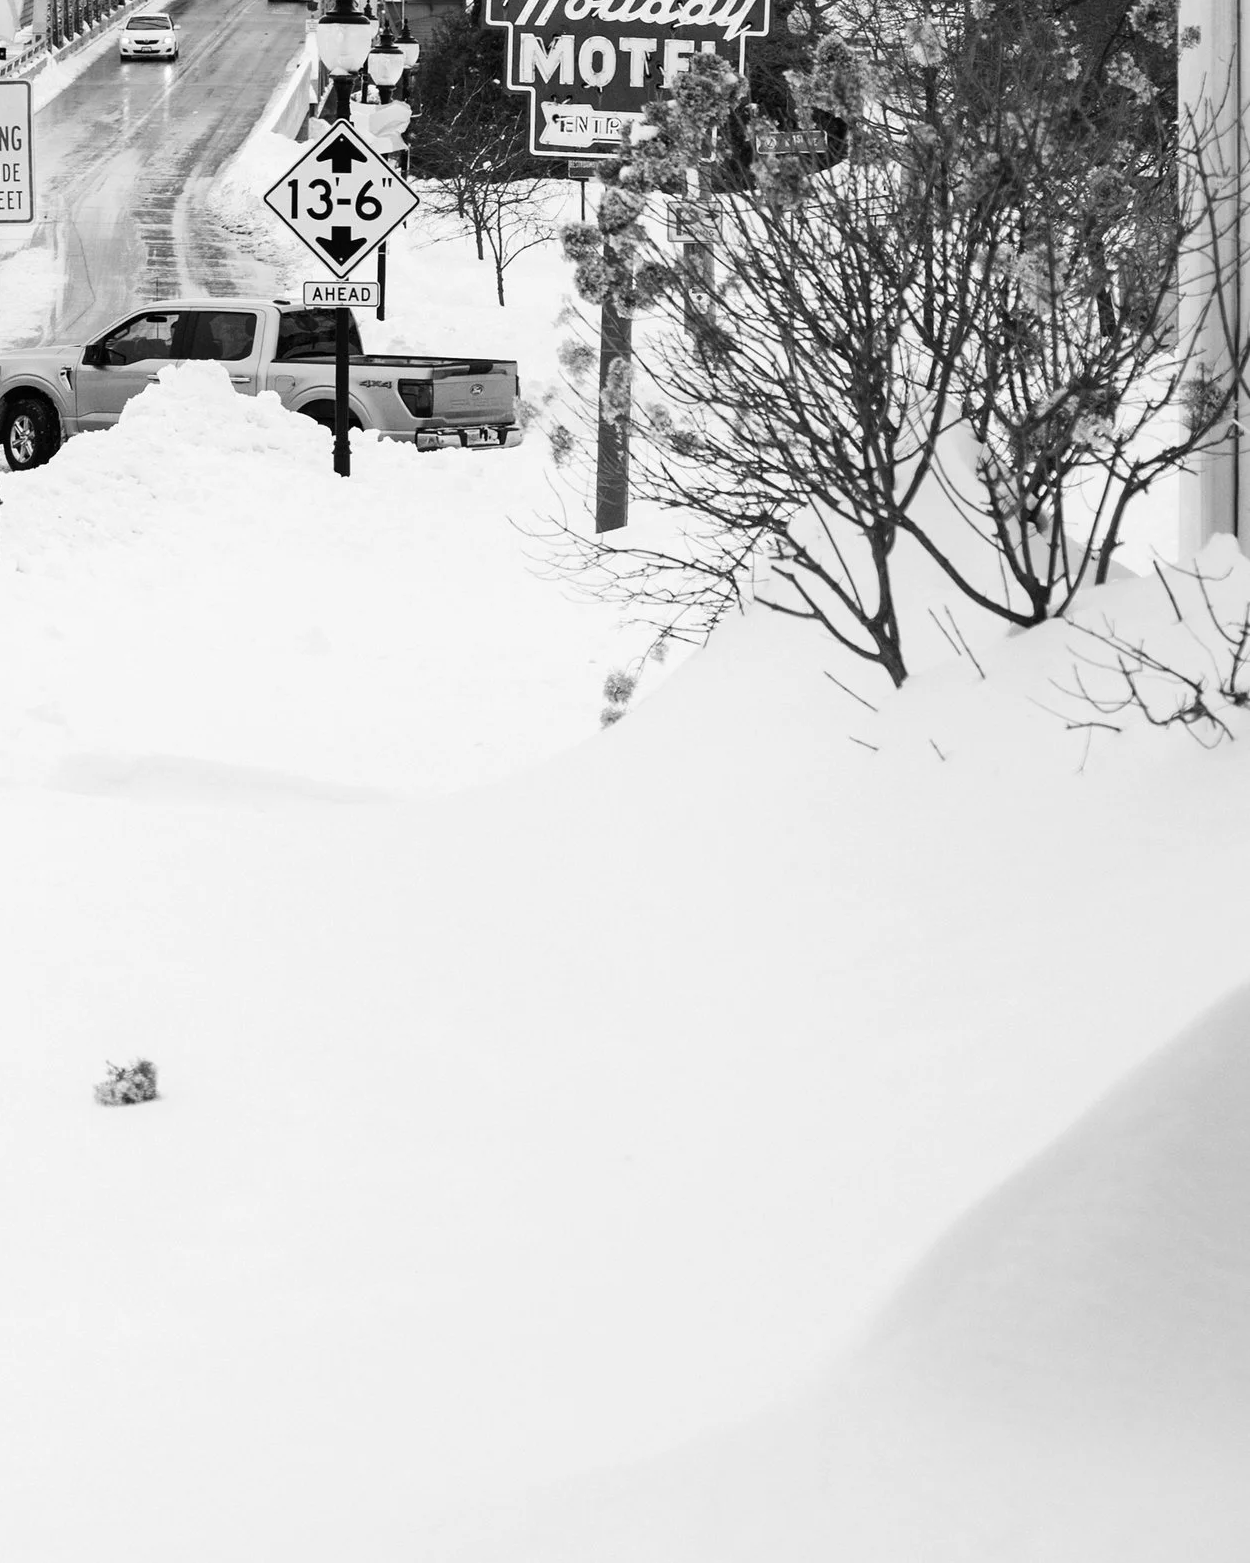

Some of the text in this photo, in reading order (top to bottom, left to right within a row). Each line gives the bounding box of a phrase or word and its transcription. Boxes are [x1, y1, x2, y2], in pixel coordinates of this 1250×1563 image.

[519, 32, 716, 90] MOTE
[559, 116, 622, 136] ENTR
[287, 177, 392, 221] 13'-6"
[312, 287, 371, 302] AHEAD
